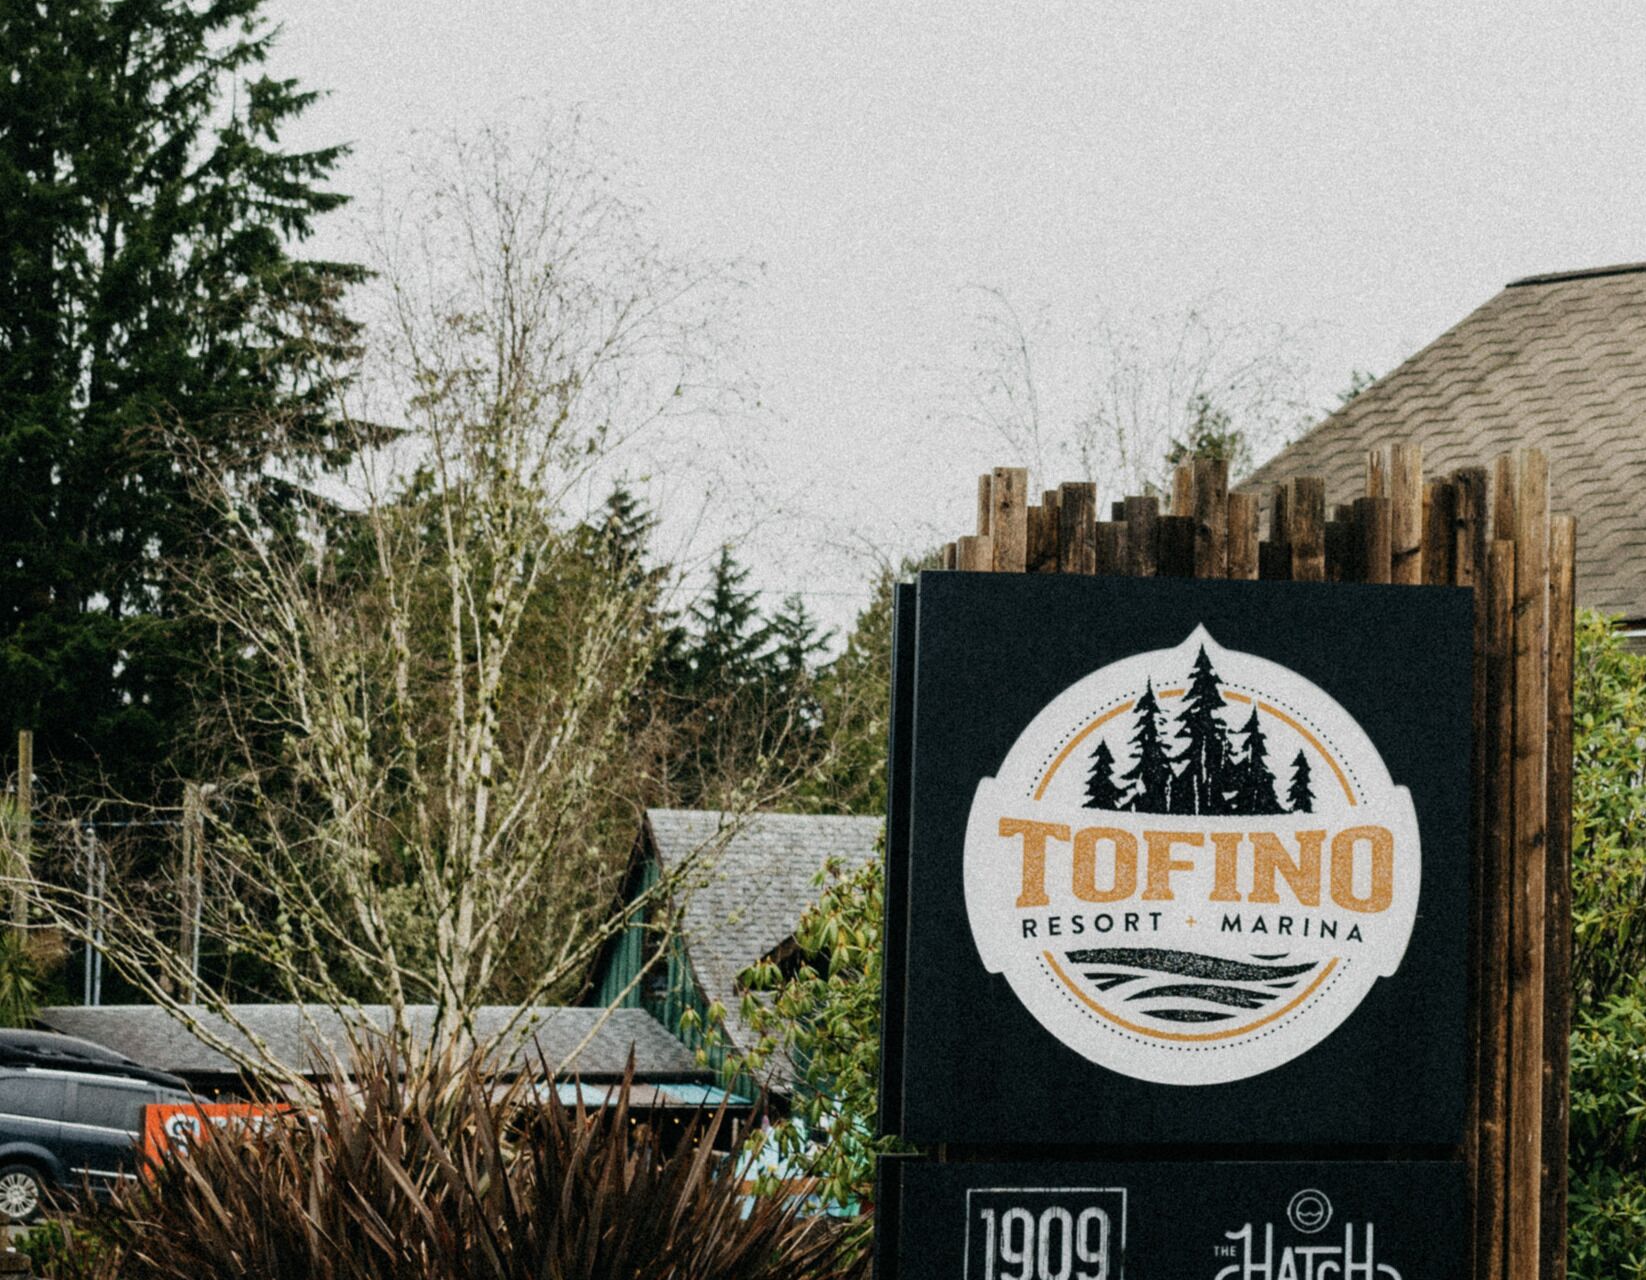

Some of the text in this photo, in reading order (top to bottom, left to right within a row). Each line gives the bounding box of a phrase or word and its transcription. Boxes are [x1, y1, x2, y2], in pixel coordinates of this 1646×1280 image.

[998, 817, 1394, 913] TOFINO
[1022, 912, 1162, 939] RESORT
[1220, 913, 1364, 943] MARINA
[1214, 1245, 1237, 1257] THE
